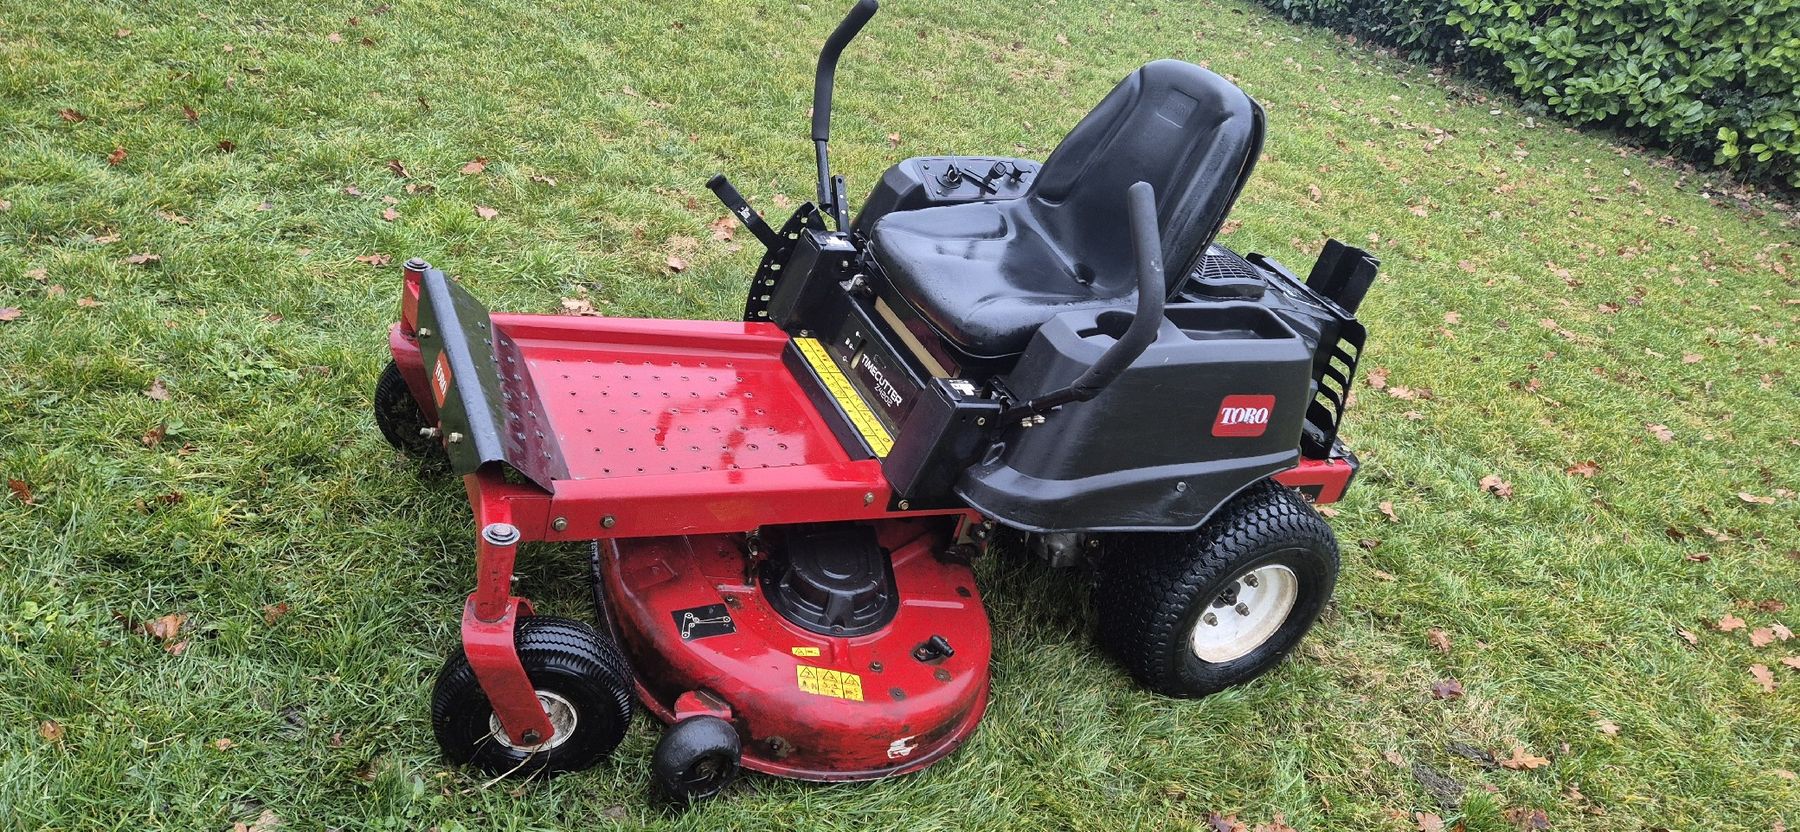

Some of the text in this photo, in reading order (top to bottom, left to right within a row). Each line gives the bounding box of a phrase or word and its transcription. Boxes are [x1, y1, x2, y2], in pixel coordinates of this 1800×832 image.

[861, 354, 903, 406] TIMECUTTER
[874, 383, 894, 407] Z4202
[1220, 407, 1269, 425] TORO
